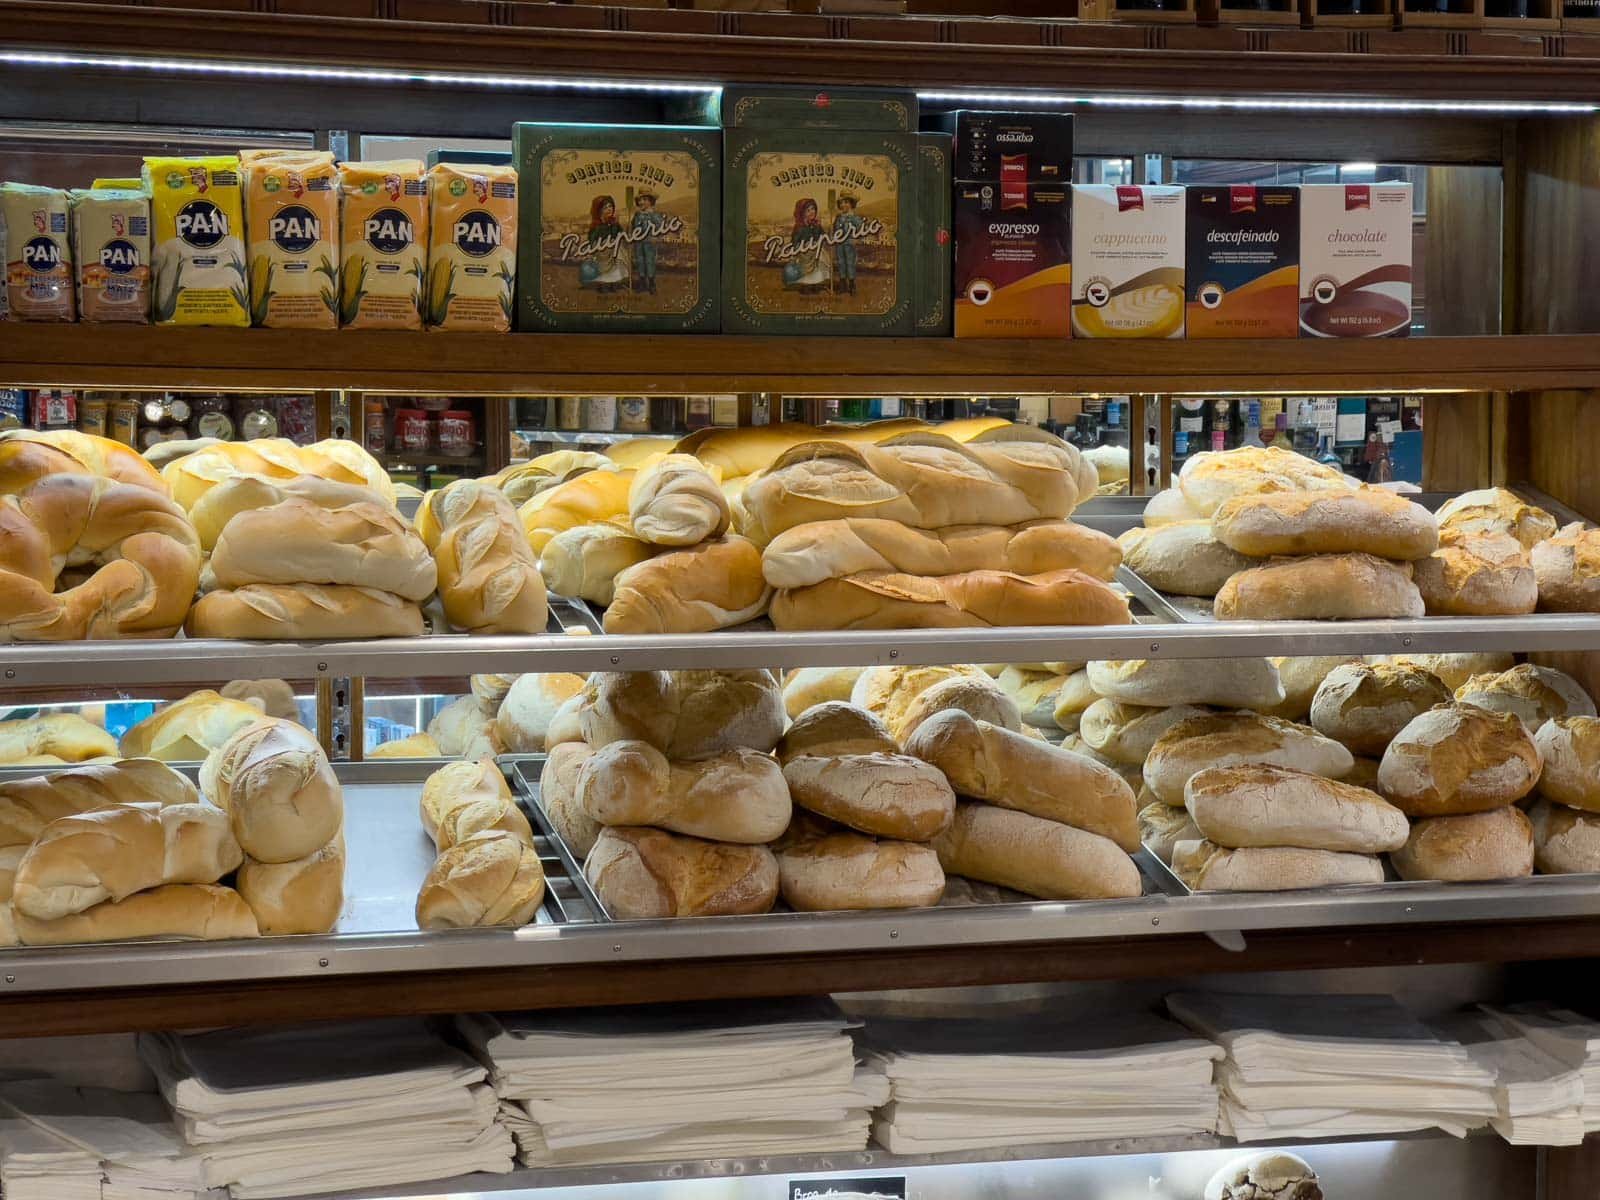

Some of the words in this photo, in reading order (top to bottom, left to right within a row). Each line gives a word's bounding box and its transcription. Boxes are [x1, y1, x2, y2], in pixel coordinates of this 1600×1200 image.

[988, 223, 1040, 237] expresso
[1327, 228, 1387, 242] chocolate
[1094, 233, 1168, 247] cappuccino
[1207, 229, 1280, 246] descafeinado
